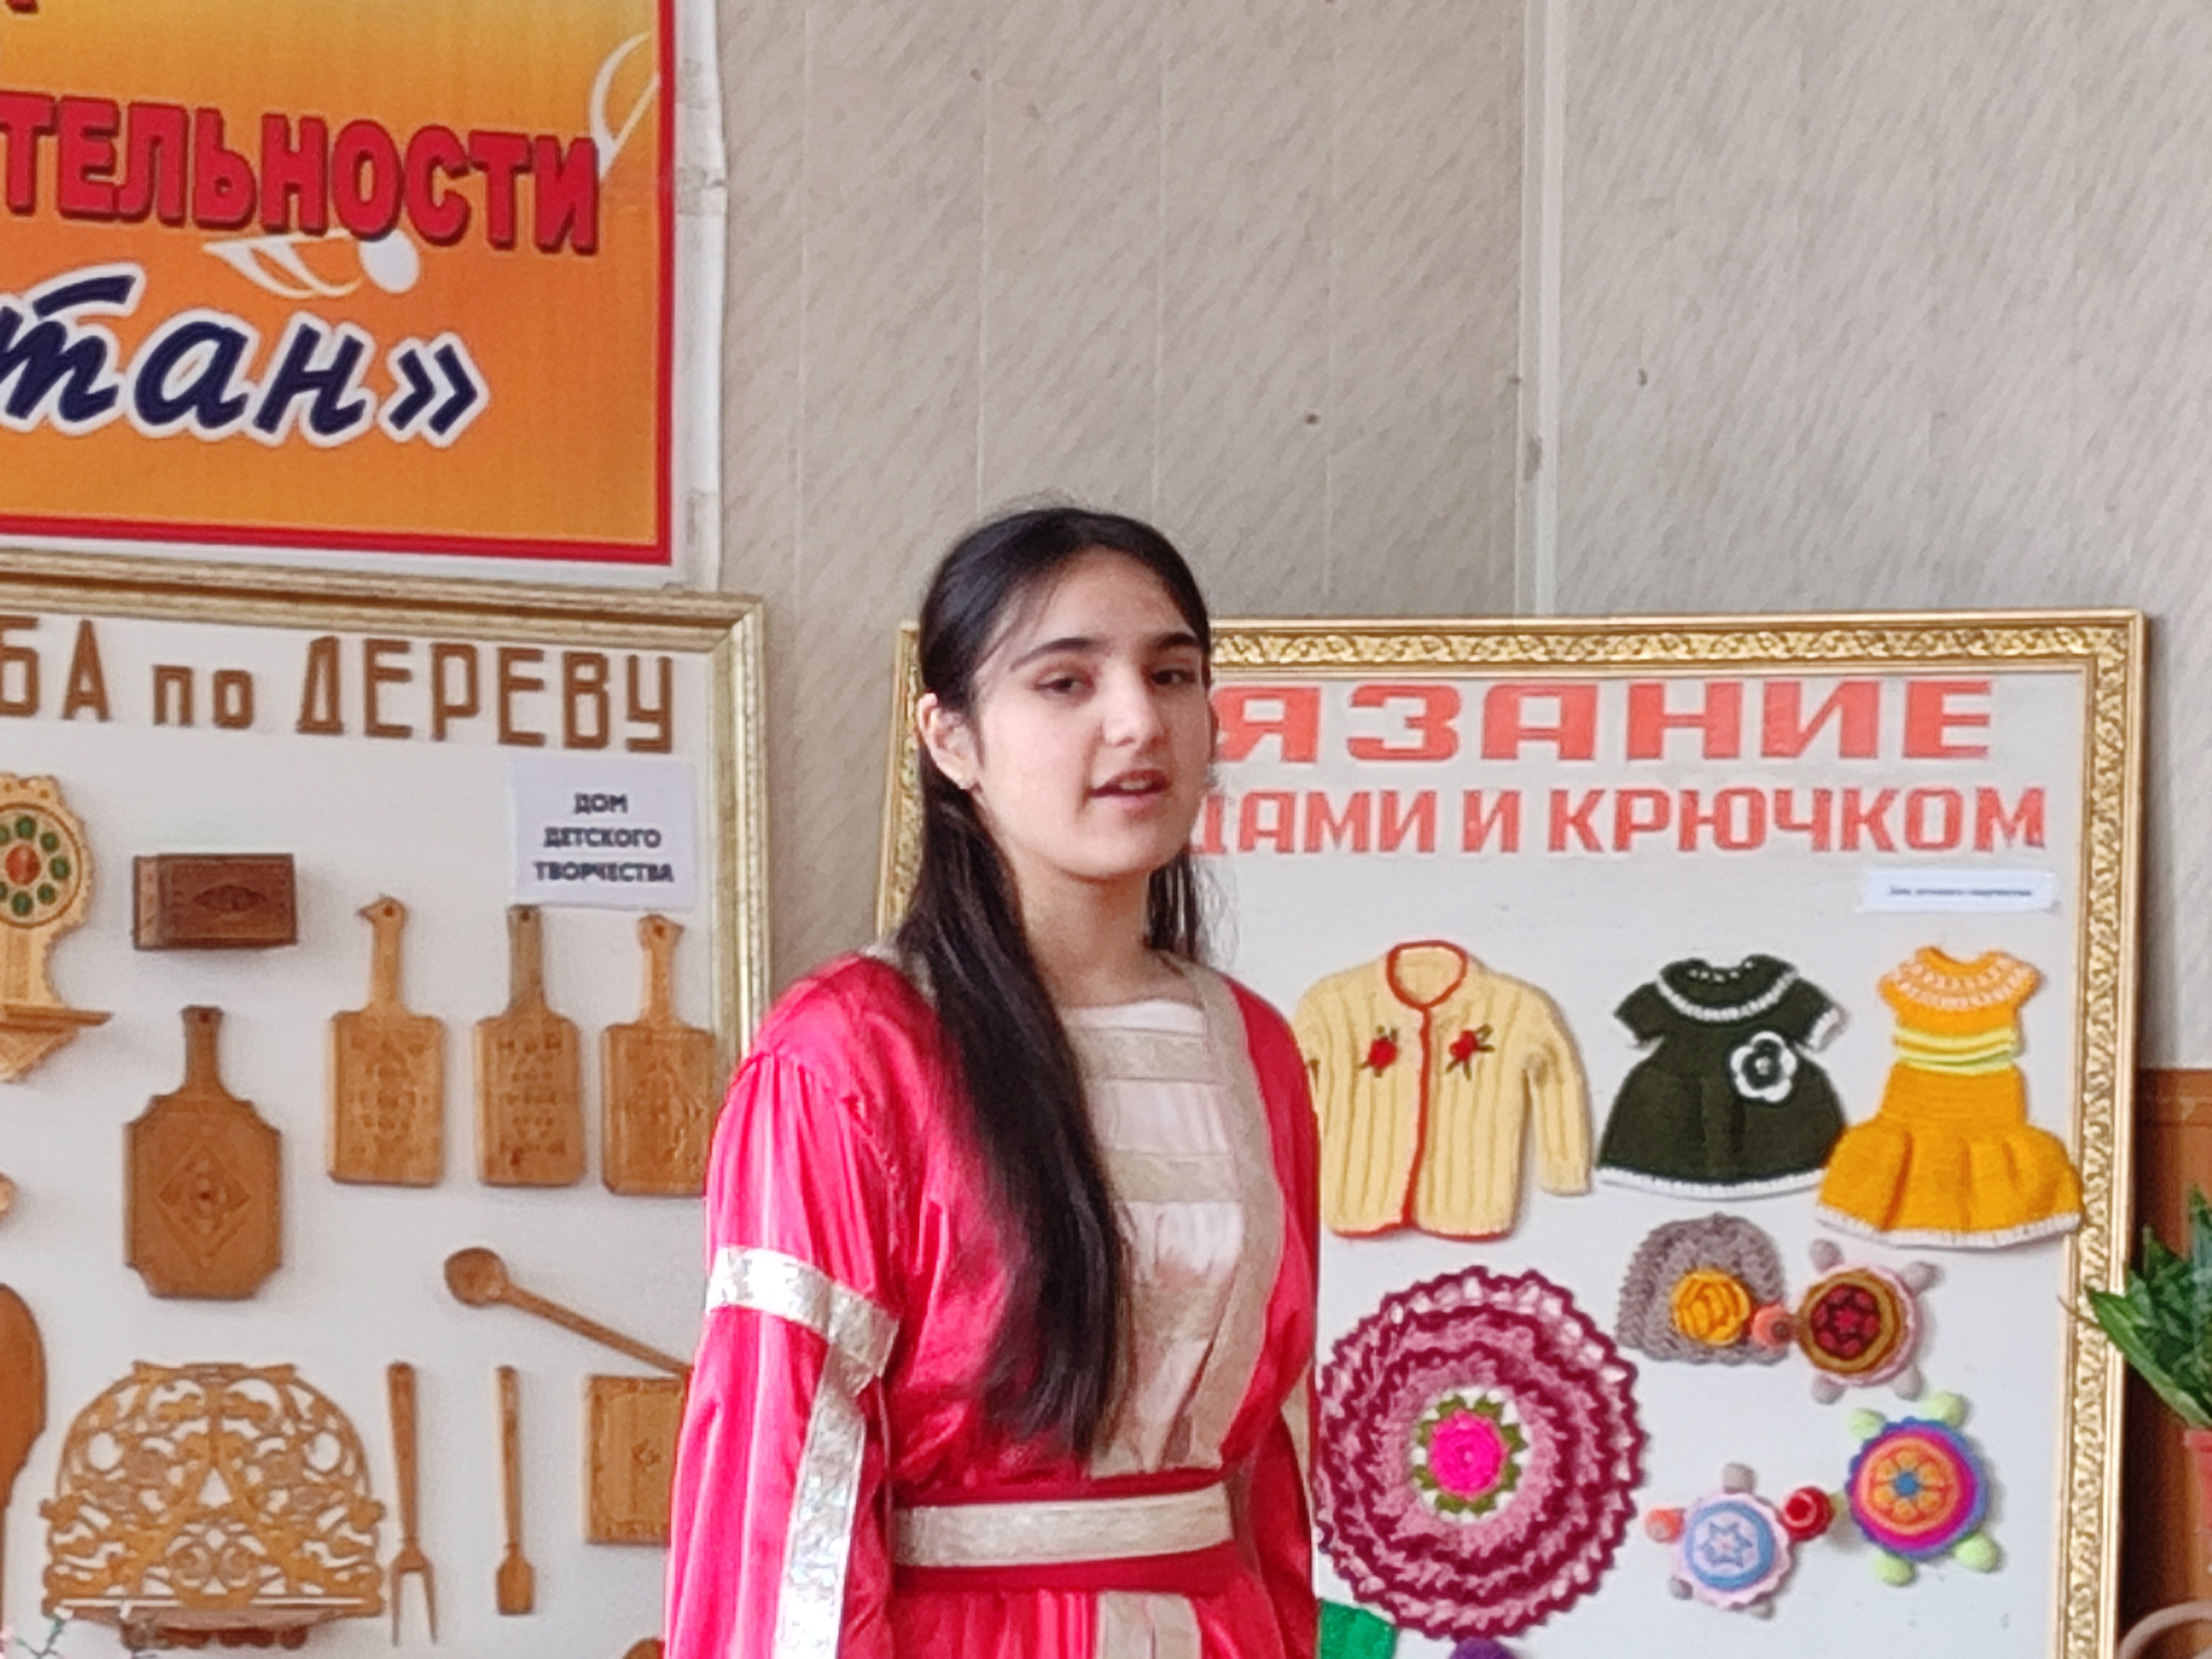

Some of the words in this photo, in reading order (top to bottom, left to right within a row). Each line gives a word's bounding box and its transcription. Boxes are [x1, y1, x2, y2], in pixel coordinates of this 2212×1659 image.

[0, 90, 599, 254] ТЕЛЬНОСТИ
[153, 664, 255, 729] по
[296, 635, 673, 753] ДЕРЕВУ
[1214, 680, 1992, 763] ЯЗАНИЕ
[573, 792, 628, 815] ДОМ
[1462, 790, 1520, 852] И
[1548, 787, 2045, 852] КРЮЧКОМ
[543, 826, 662, 848] ДЕТСКОГО
[534, 860, 675, 882] ТВОРЧЕСТВА
